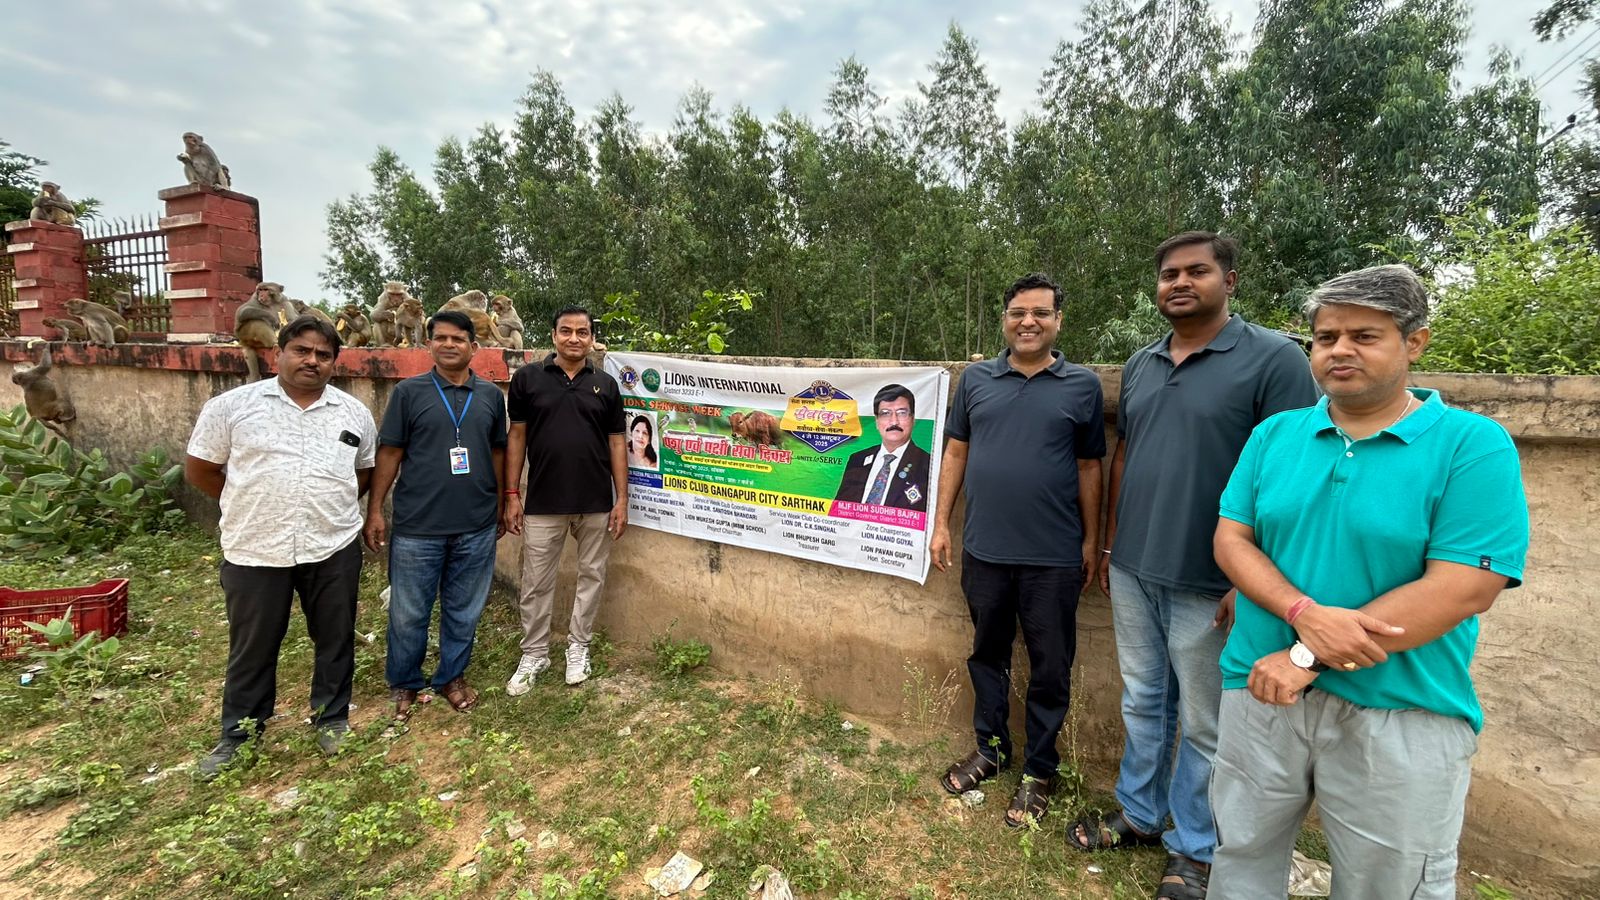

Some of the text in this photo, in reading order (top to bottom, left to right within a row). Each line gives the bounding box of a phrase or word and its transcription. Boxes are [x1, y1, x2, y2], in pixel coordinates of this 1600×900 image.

[665, 372, 786, 395] LIONS INTERNATIONAL
[682, 388, 694, 396] 3233
[624, 398, 646, 407] IONS
[691, 404, 722, 416] WEEK
[663, 436, 682, 454] पशु
[685, 438, 702, 452] एवं
[704, 440, 728, 456] पक्षी
[759, 444, 792, 464] दिवस
[820, 456, 843, 465] SERVE
[664, 476, 688, 490] LIONS
[690, 480, 709, 494] CLUB
[710, 485, 756, 502] GANGAPUR
[759, 492, 779, 506] CITY
[782, 496, 825, 512] SARTHAK
[769, 510, 786, 518] Service
[814, 516, 850, 527] Co-coordinator
[853, 504, 869, 512] LION
[870, 506, 896, 517] SUDHIR
[898, 510, 920, 520] BAJPAI
[716, 519, 730, 527] GUPTA
[722, 527, 742, 536] Chairman
[880, 526, 911, 538] Chairperson
[796, 534, 820, 543] BHUPESH
[875, 534, 895, 544] ANAND
[896, 537, 914, 547] GOYAL
[861, 545, 913, 560] LION PAVAN GUPTA
[881, 556, 905, 568] Secretary
